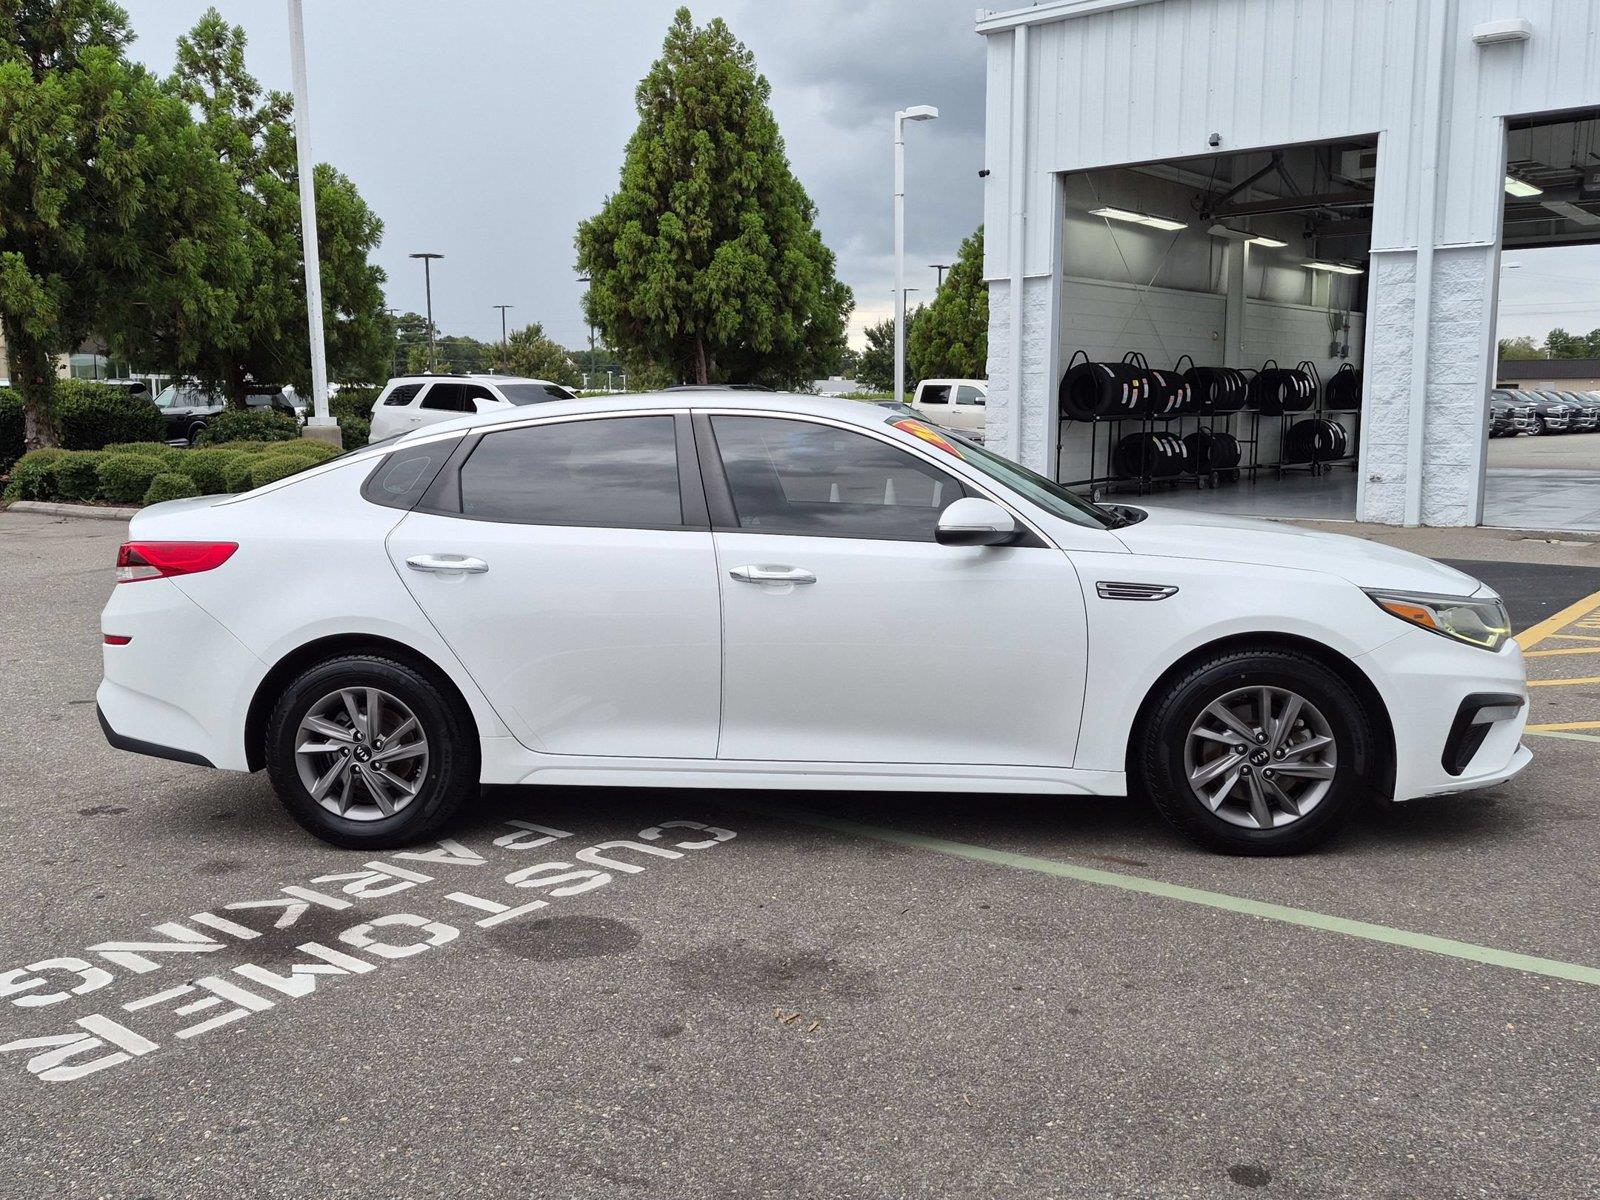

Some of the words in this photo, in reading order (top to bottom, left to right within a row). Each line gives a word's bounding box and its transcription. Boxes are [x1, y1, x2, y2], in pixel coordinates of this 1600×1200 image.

[356, 746, 370, 761] KIA
[1251, 751, 1268, 763] KIA
[0, 820, 574, 1007] PARKING
[0, 820, 737, 1081] CUSTOMER
